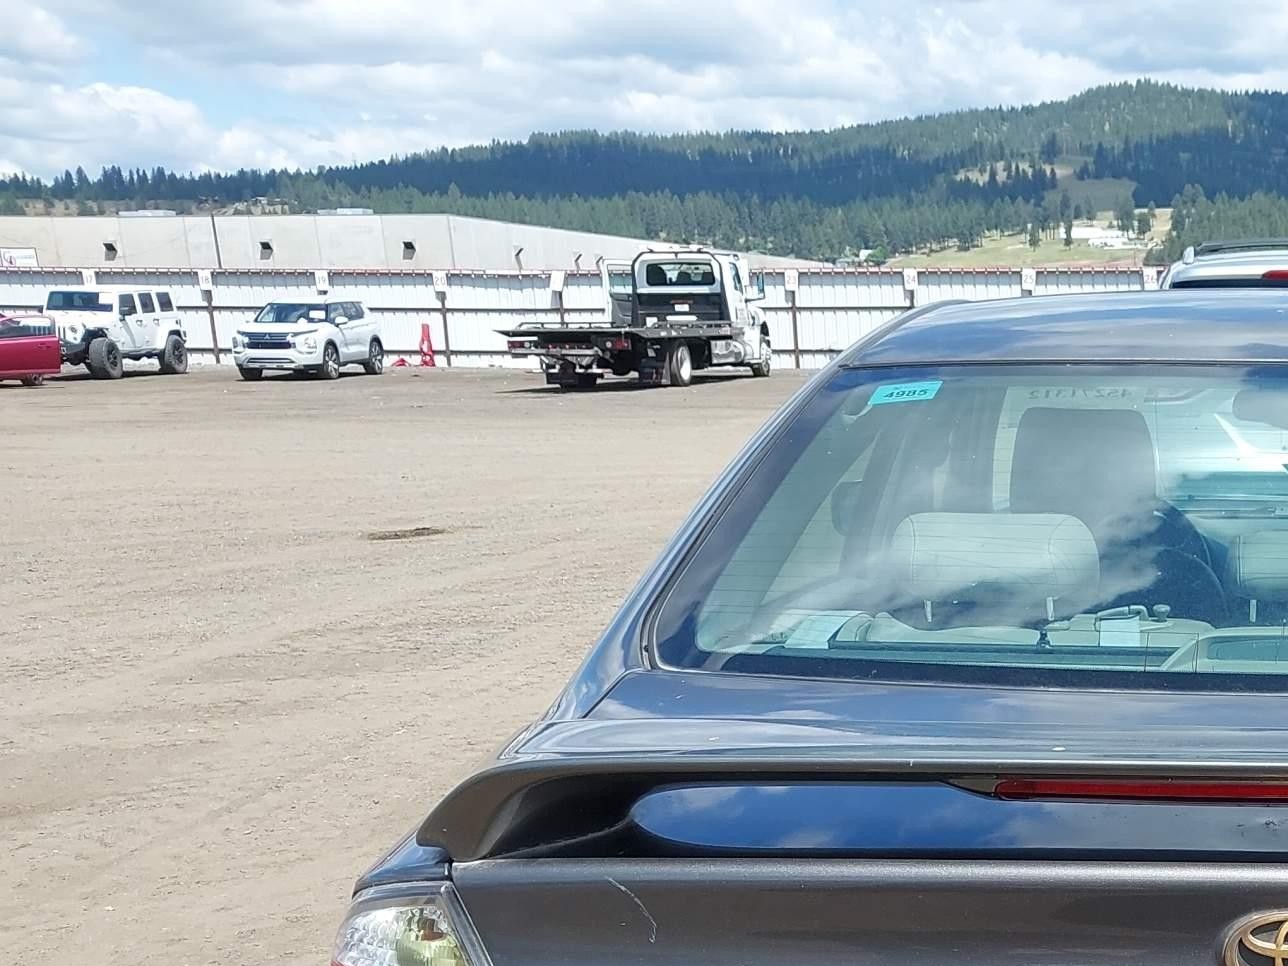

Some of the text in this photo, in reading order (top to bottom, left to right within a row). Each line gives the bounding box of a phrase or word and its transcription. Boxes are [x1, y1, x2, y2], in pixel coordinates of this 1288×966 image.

[434, 275, 446, 286] 20
[905, 274, 916, 285] 24
[1023, 274, 1034, 285] 25
[883, 388, 929, 398] 4985
